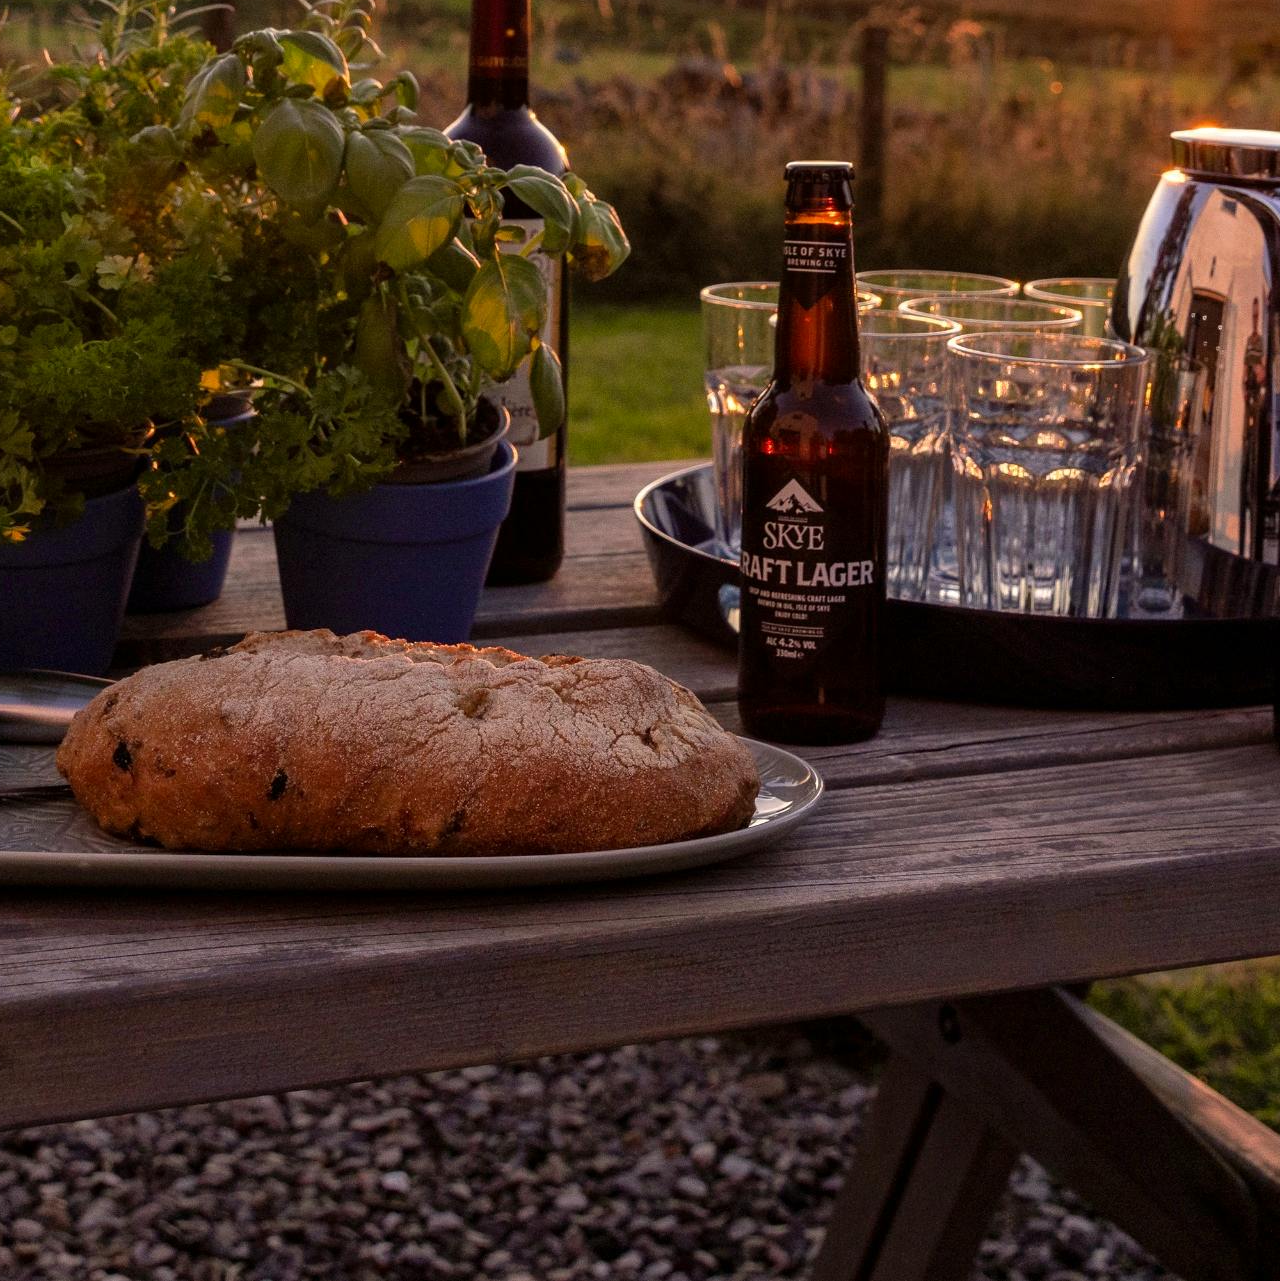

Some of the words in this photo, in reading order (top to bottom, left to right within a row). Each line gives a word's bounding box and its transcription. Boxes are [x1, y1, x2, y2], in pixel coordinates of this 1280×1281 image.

[784, 246, 798, 256] SLE
[800, 246, 814, 256] OF
[818, 247, 847, 258] SKYE
[787, 257, 822, 267] BREWING
[763, 521, 824, 551] SKYE
[740, 551, 793, 585] RAFT
[796, 560, 874, 588] LAGER
[807, 594, 826, 603] CRAFT
[827, 595, 846, 603] LAGER
[766, 636, 778, 646] ALC
[778, 637, 801, 649] 4.2%
[802, 640, 817, 650] VOL
